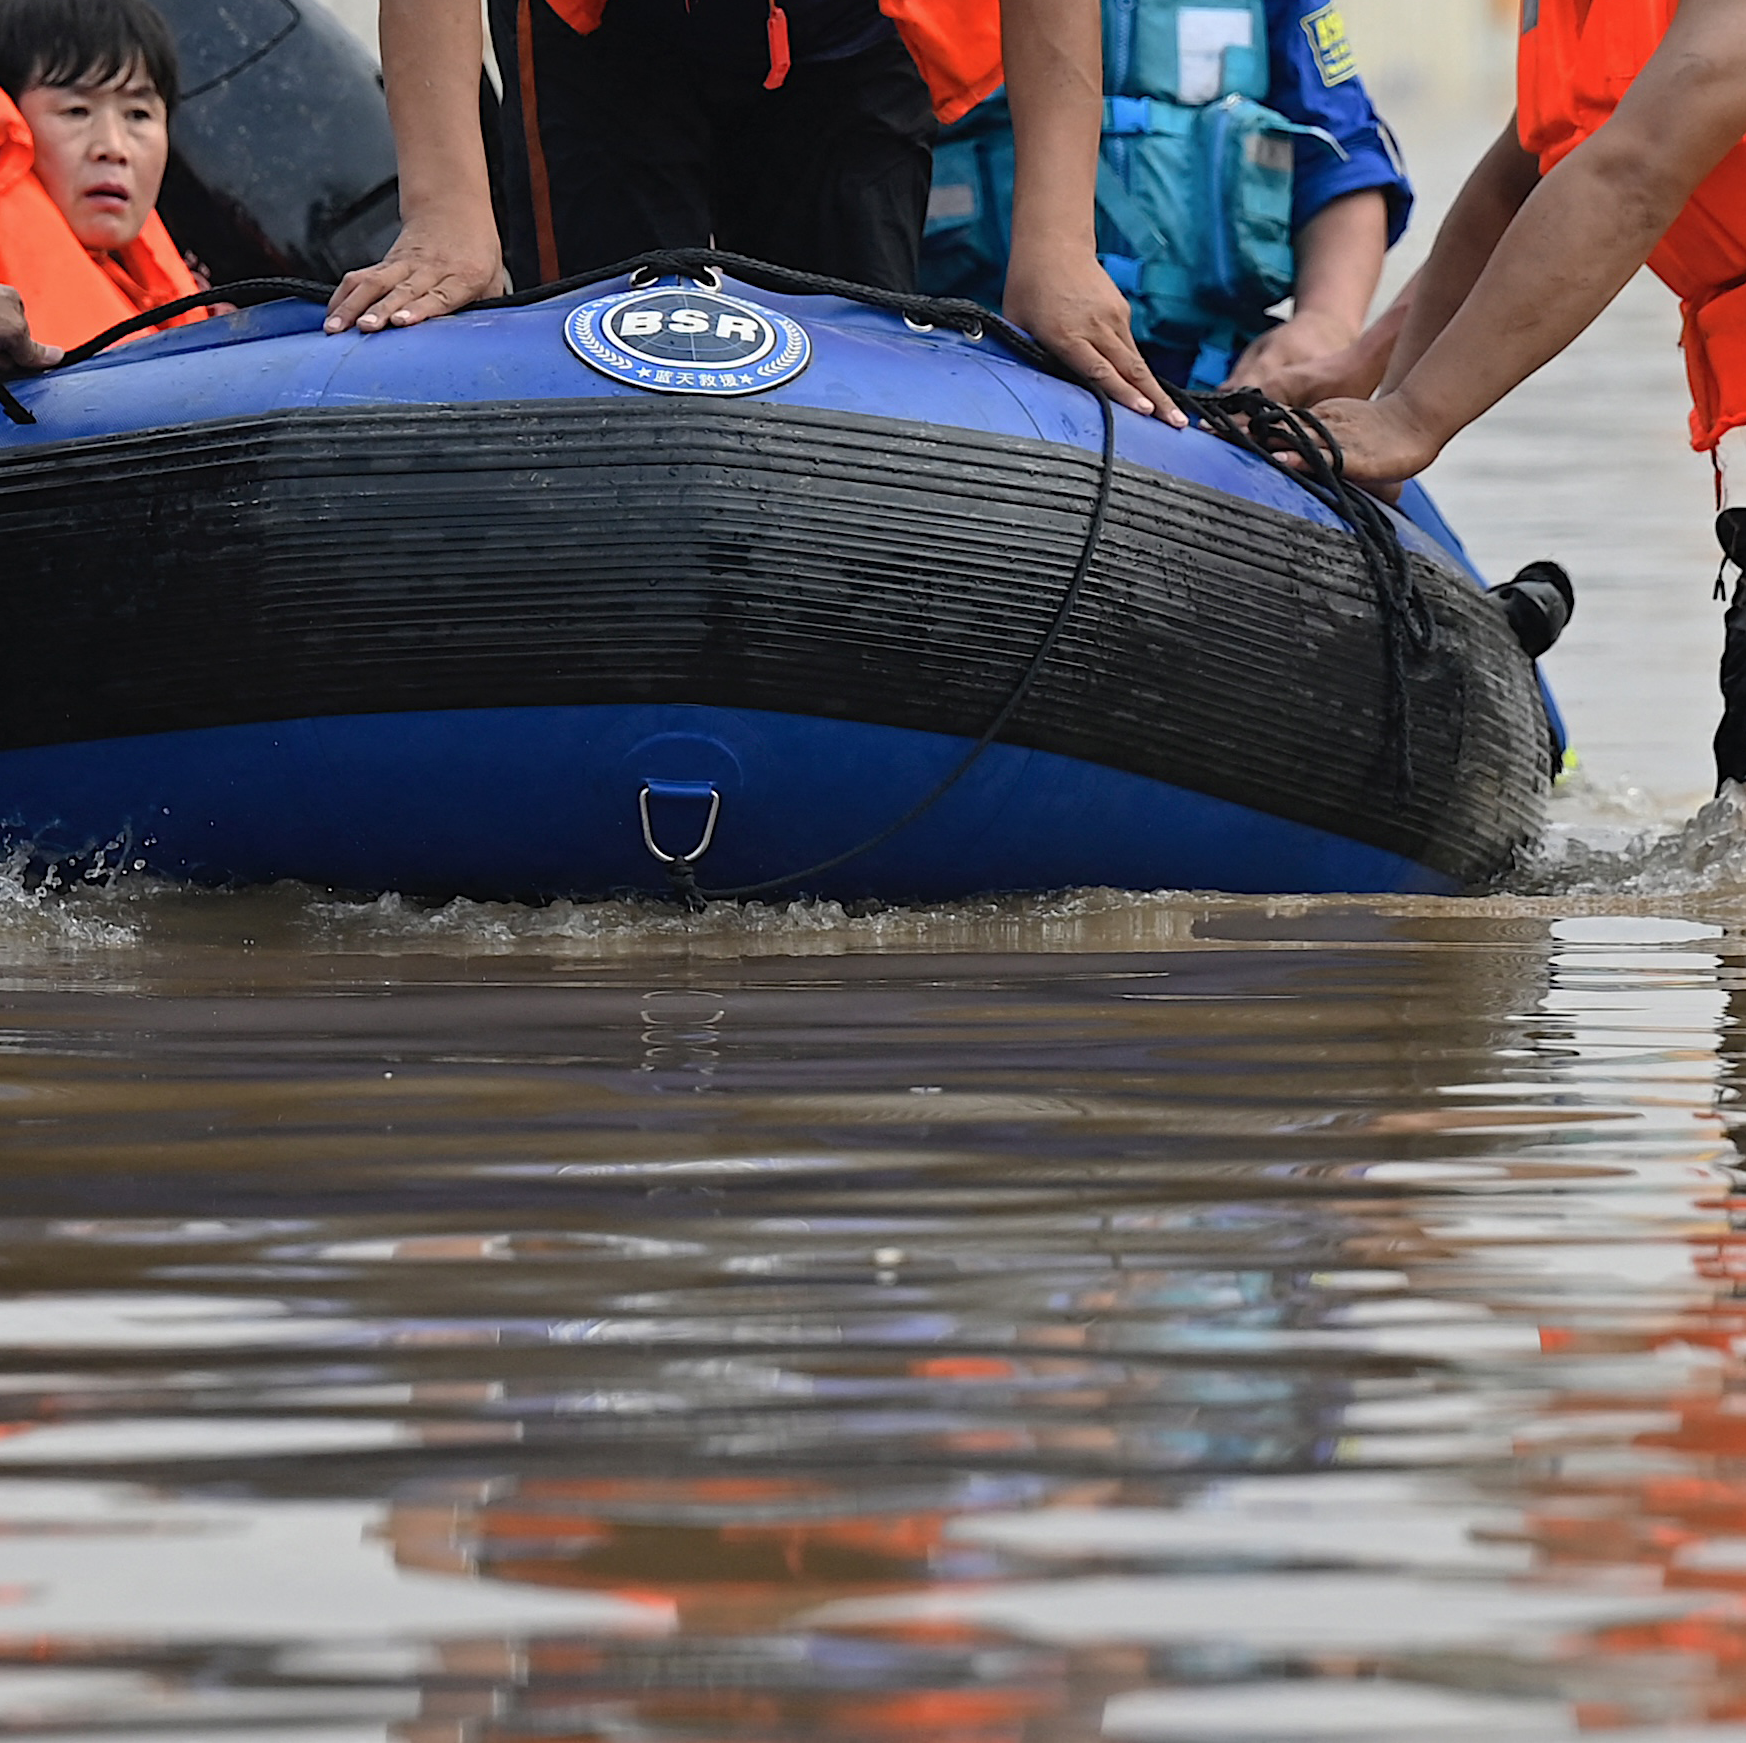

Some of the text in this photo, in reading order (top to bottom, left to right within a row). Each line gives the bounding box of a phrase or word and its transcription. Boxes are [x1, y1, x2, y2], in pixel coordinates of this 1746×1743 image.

[619, 309, 759, 342] BSR
[653, 369, 739, 388] 蓝天救援
